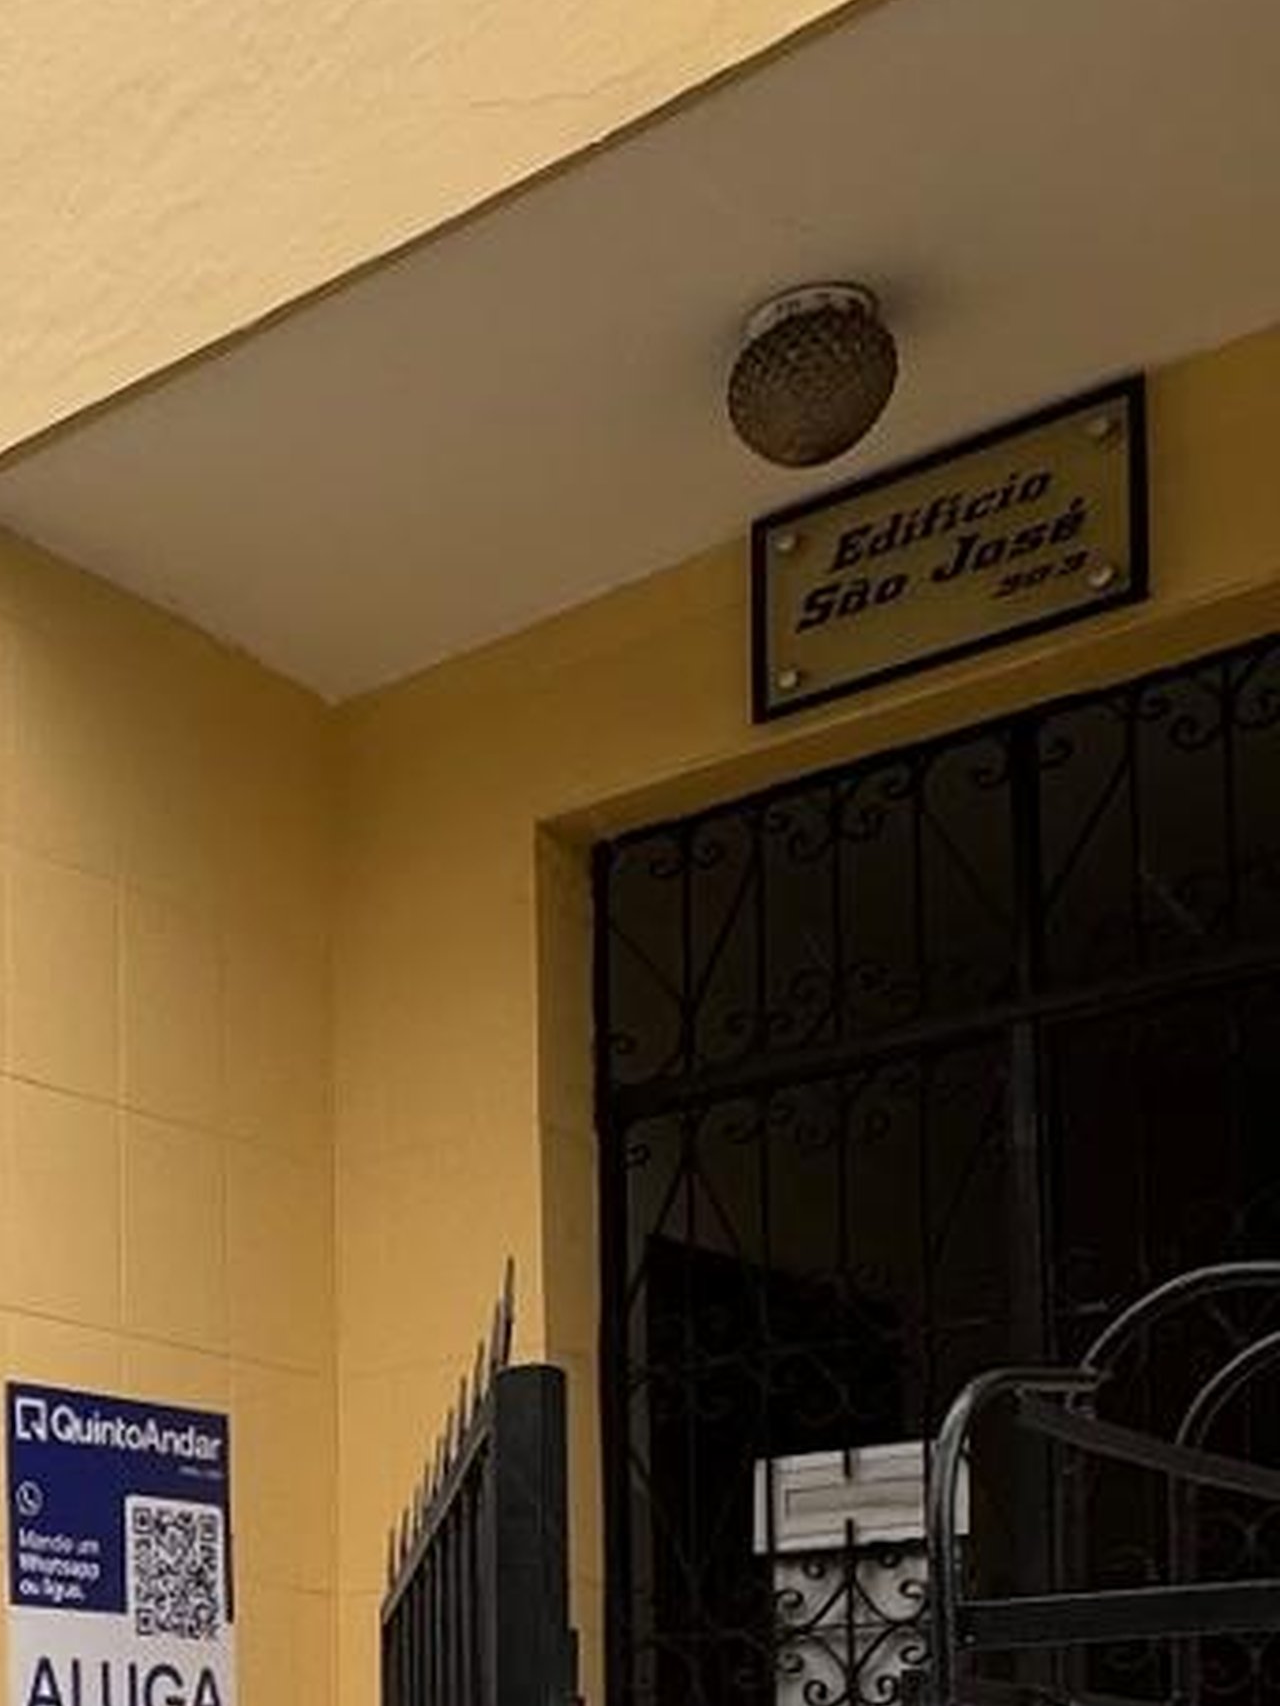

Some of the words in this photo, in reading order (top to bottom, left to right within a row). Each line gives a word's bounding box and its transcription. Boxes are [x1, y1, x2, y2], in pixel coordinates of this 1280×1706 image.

[795, 573, 910, 634] São
[931, 497, 1090, 584] José
[51, 1406, 223, 1461] QuintoAndar
